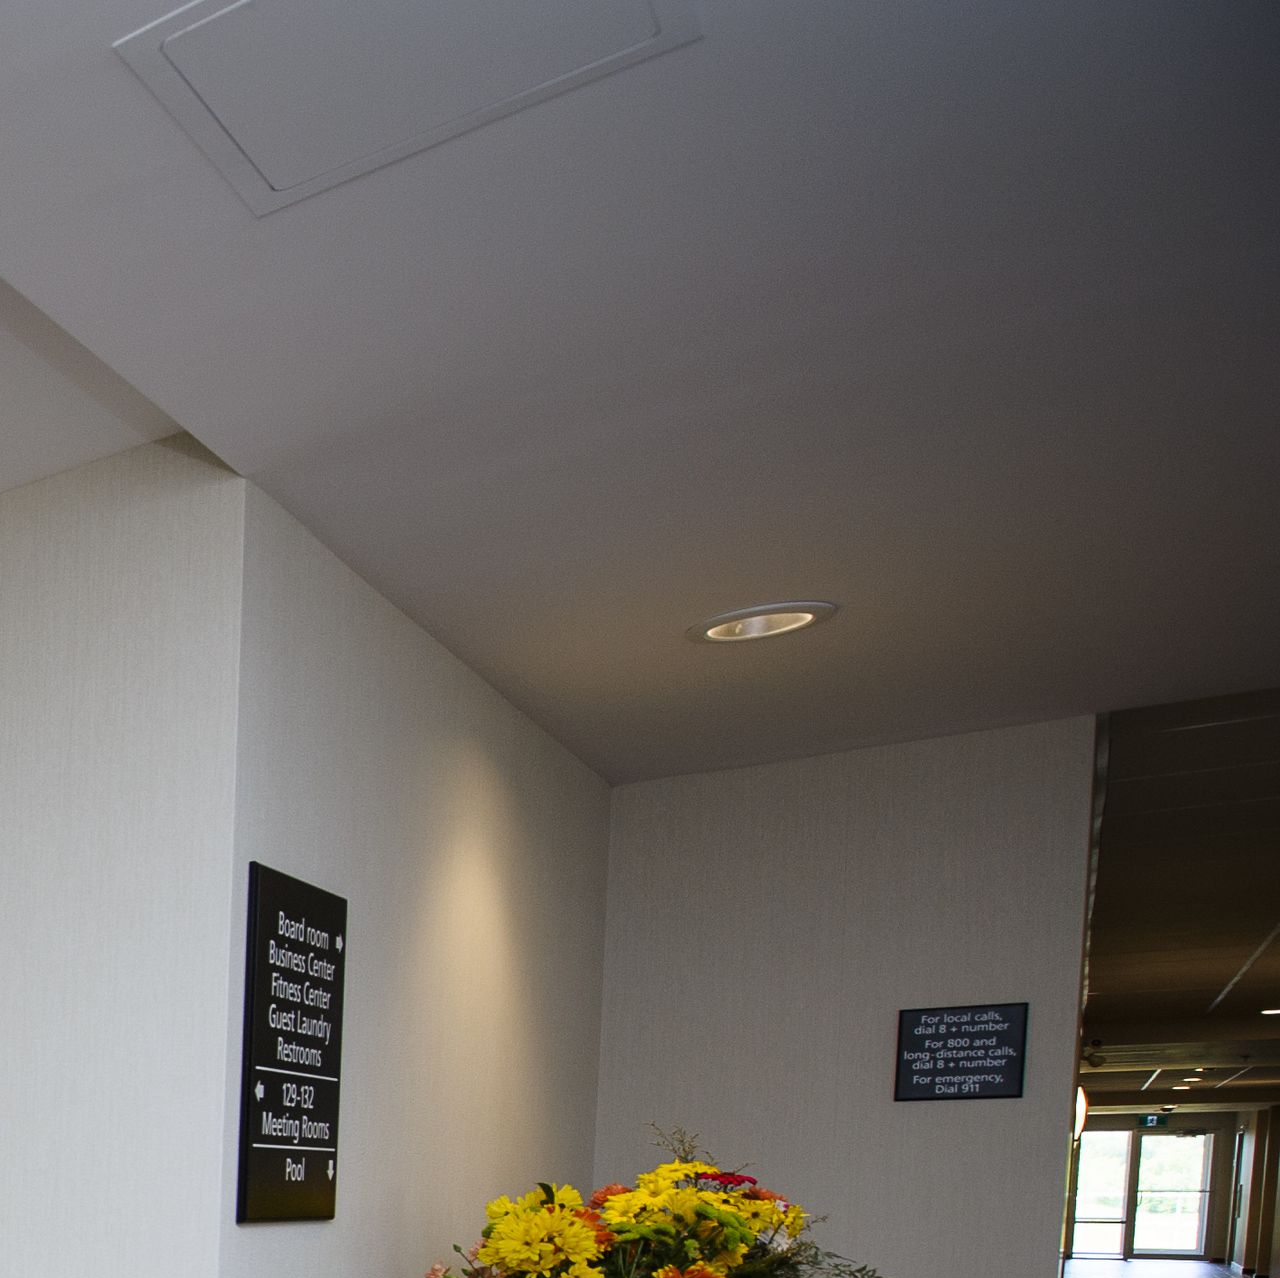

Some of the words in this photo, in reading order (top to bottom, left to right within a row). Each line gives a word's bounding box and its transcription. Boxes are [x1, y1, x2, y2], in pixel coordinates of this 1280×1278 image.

[278, 911, 305, 942] Board
[306, 927, 329, 950] room
[269, 940, 306, 973] Business
[307, 952, 335, 981] Center
[271, 972, 301, 1003] Fitness
[303, 982, 331, 1009] Center
[268, 1004, 295, 1032] Guest
[297, 1010, 332, 1045] Laundry
[914, 1025, 935, 1035] dial
[938, 1024, 947, 1034] 8
[961, 1022, 1009, 1032] number
[921, 1015, 940, 1024] For
[944, 1013, 971, 1023] local
[277, 1037, 322, 1067] Restrooms
[904, 1048, 985, 1061] long-distance
[925, 1040, 944, 1049] For
[948, 1038, 970, 1048] 800
[973, 1037, 997, 1046] and
[912, 1060, 933, 1070] dial
[937, 1060, 945, 1069] 8
[959, 1058, 1008, 1068] number
[913, 1076, 932, 1084] For
[936, 1084, 958, 1094] Dial
[961, 1084, 980, 1093] 911
[282, 1083, 314, 1109] 129-132
[261, 1111, 300, 1143] Meeting
[301, 1115, 330, 1140] Rooms
[285, 1157, 305, 1182] Pool
